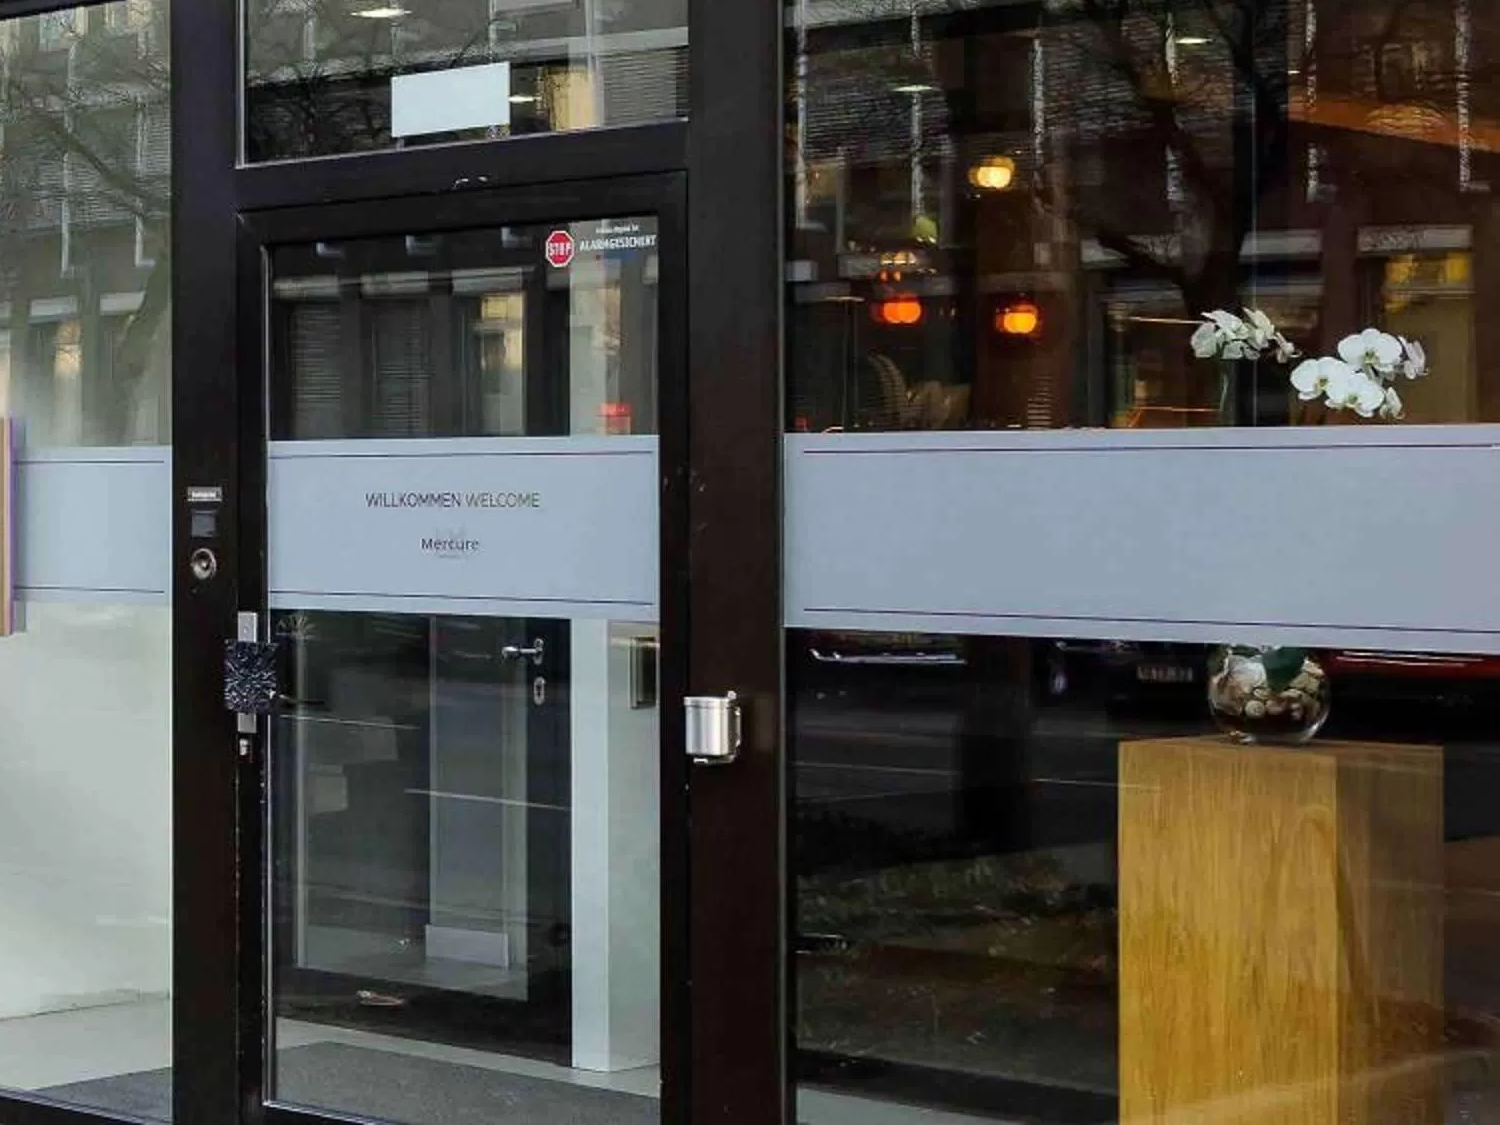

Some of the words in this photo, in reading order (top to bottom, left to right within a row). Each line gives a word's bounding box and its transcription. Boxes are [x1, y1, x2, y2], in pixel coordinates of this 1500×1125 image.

[548, 242, 573, 256] STOP
[365, 492, 461, 508] WILLKOMMEN
[466, 492, 541, 508] WELCOME
[420, 537, 480, 551] Mercure
